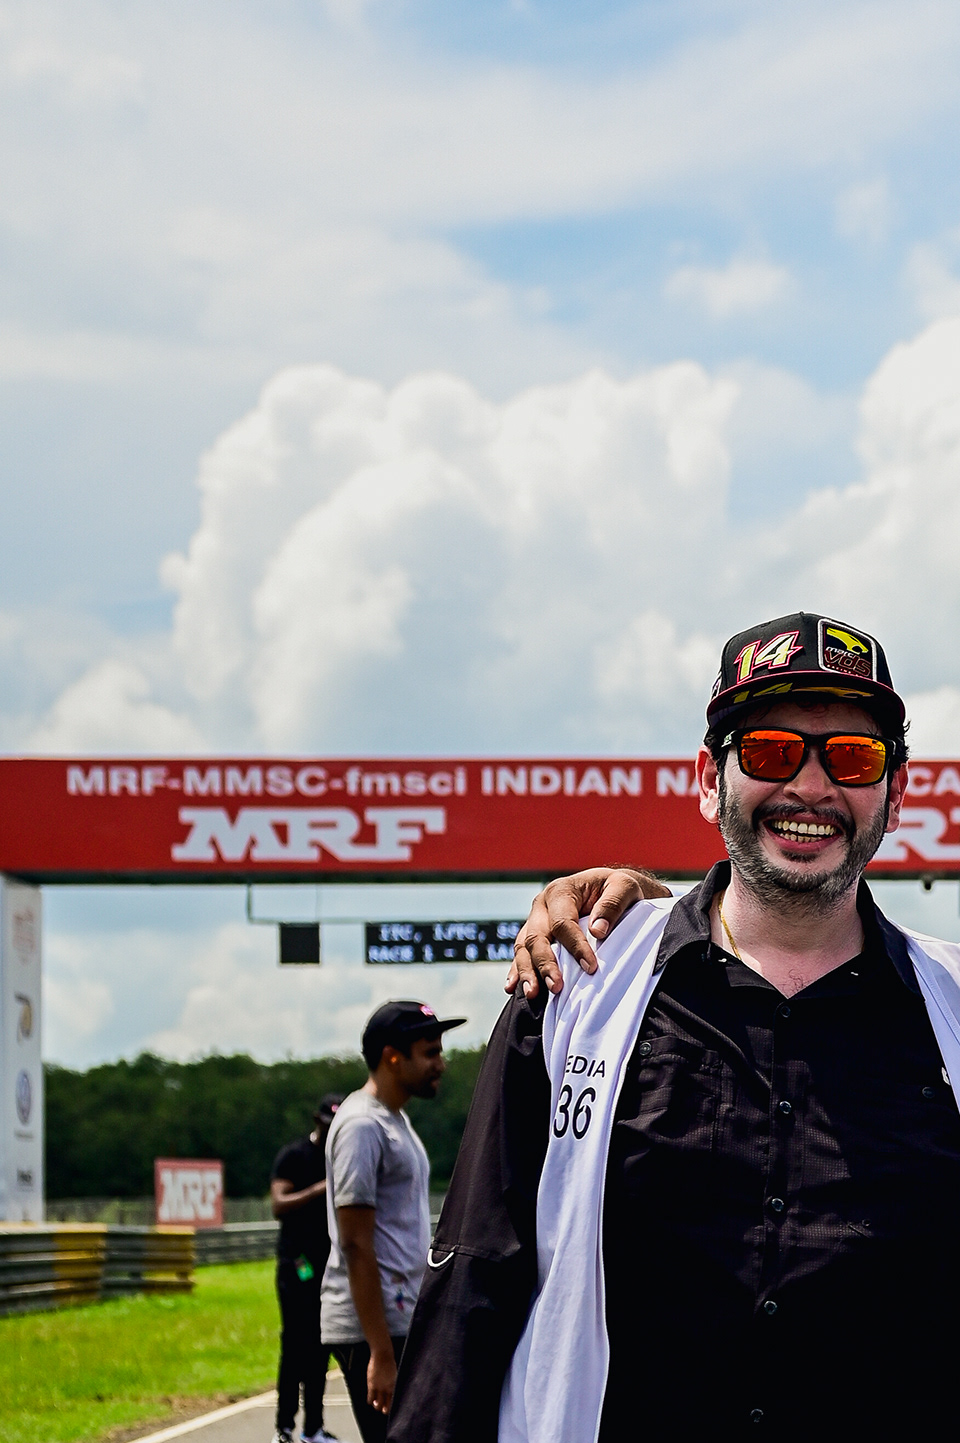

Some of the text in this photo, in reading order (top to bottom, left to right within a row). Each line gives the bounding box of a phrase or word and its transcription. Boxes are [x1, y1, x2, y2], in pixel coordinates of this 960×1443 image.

[734, 630, 803, 684] 14
[825, 646, 857, 658] marc
[67, 767, 467, 797] MRF-MMSC-fmsci
[481, 768, 642, 797] INDIAN
[171, 806, 447, 863] MRF
[553, 1084, 597, 1140] 36
[159, 1169, 222, 1222] MRF
